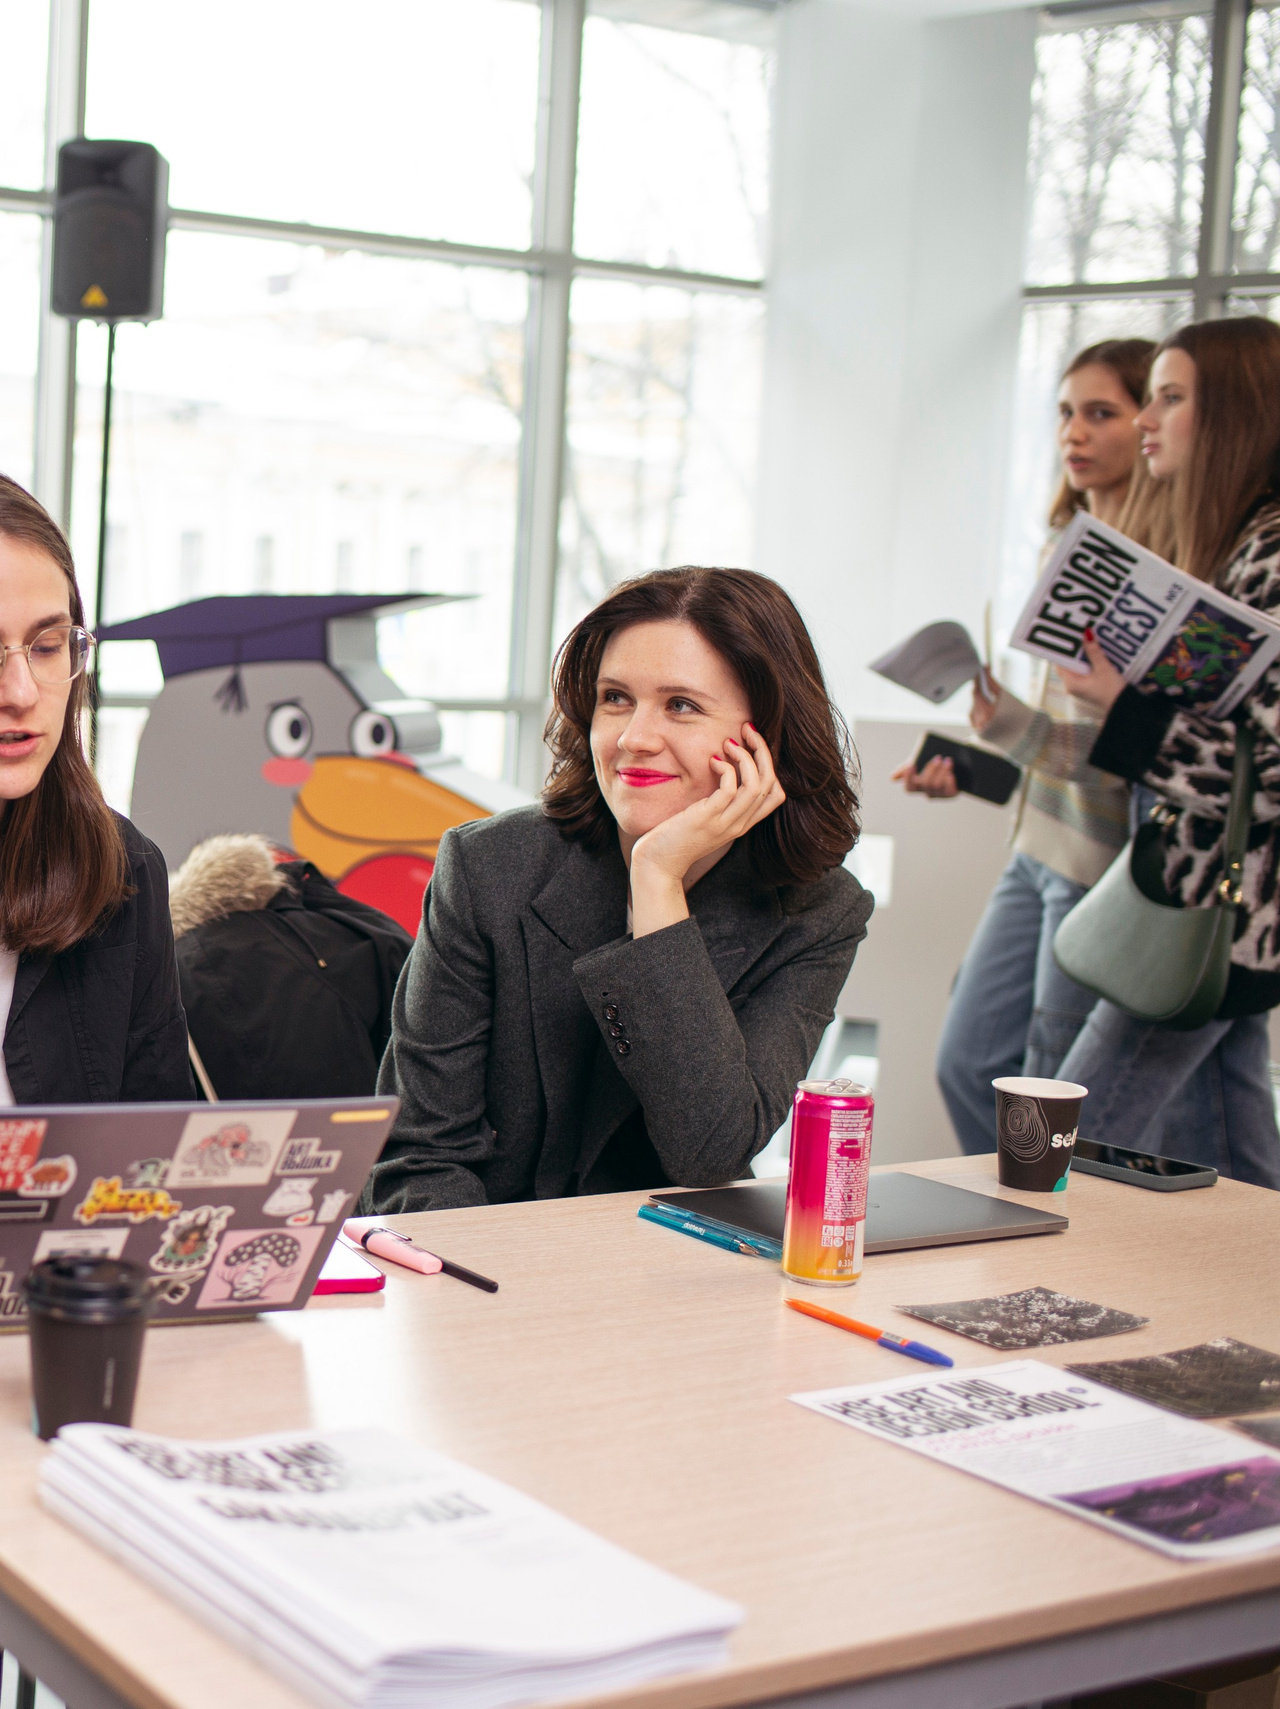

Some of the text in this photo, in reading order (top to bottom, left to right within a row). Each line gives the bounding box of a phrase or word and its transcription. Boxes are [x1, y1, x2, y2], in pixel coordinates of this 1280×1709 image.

[1025, 530, 1138, 658] DESIGN
[1079, 582, 1167, 675] IGEST
[865, 1406, 994, 1438] DESIGN
[967, 1390, 1102, 1421] SCHOOL
[881, 1387, 957, 1413] ART
[936, 1378, 1016, 1401] AND
